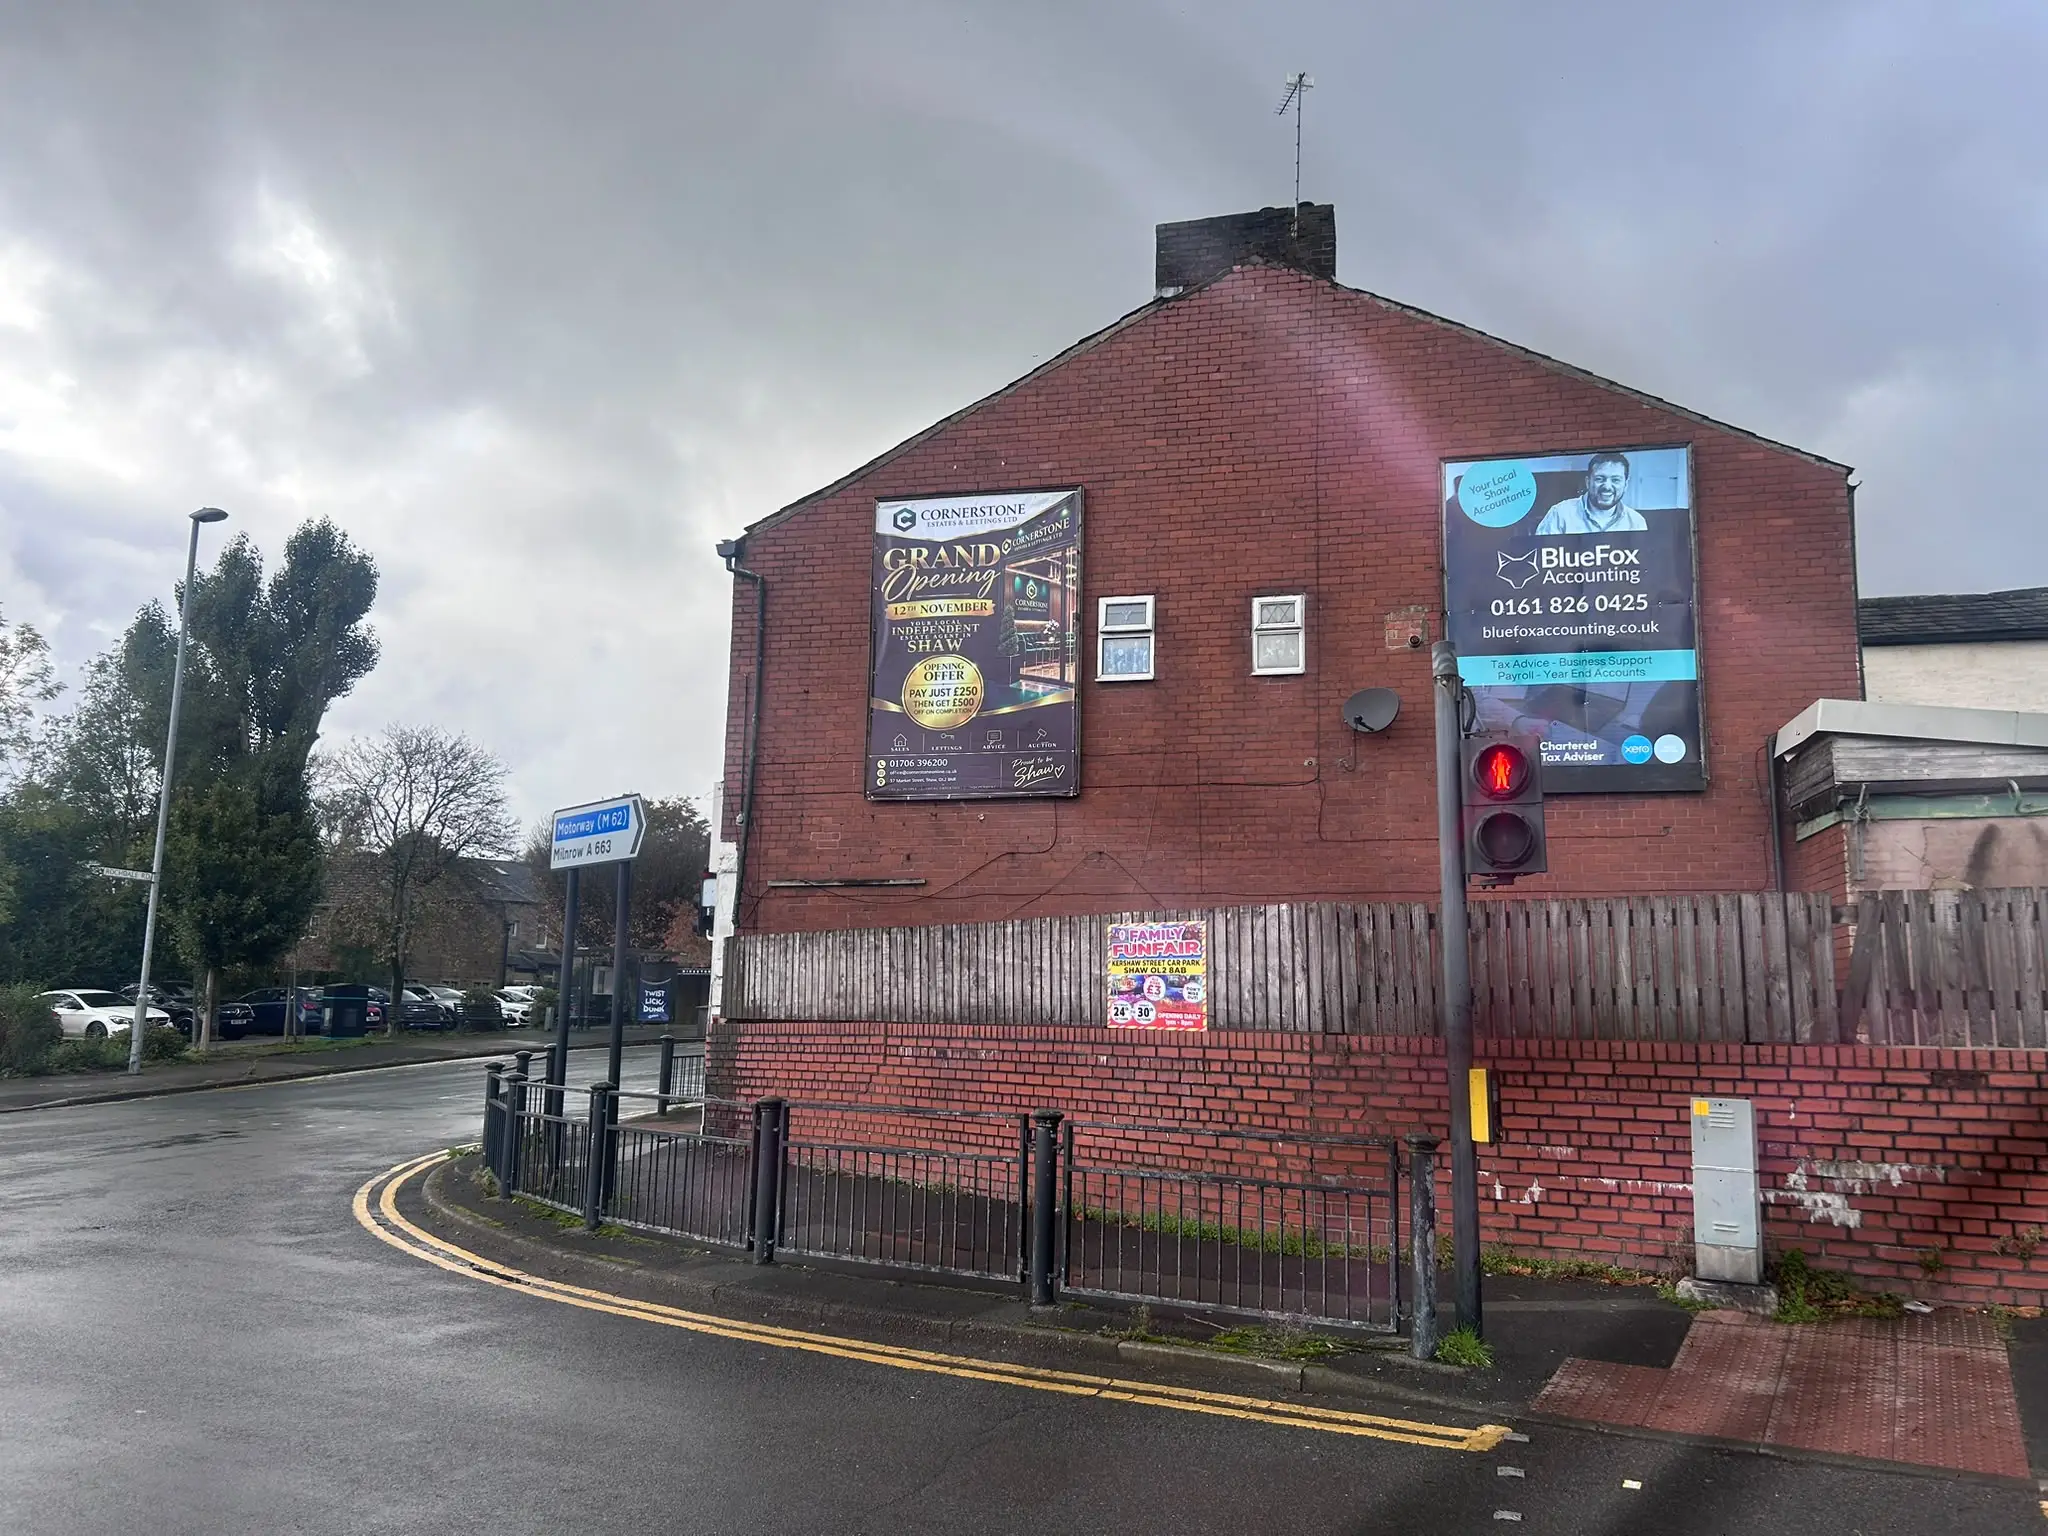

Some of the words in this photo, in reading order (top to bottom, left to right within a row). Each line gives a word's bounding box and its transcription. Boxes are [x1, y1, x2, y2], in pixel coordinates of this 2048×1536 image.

[1469, 482, 1490, 496] Your
[1492, 469, 1518, 487] Local
[1484, 484, 1511, 500] Shaw
[1472, 487, 1531, 517] Accountants
[921, 504, 1026, 521] CORNERSTONE
[927, 519, 957, 528] ESTATES
[958, 518, 964, 526] &
[965, 516, 1002, 526] LETTINGS
[1012, 517, 1070, 547] CORNERSTONE
[883, 542, 1001, 572] GRAND
[1541, 545, 1640, 569] BlueFox
[1542, 567, 1641, 585] Accounting
[881, 564, 1001, 602] Opening
[893, 604, 917, 616] 12TH
[919, 601, 988, 614] NOVEMBER
[1015, 598, 1048, 608] CORNERSTONE
[1491, 598, 1543, 616] 0161
[1550, 595, 1589, 613] 826
[1595, 593, 1648, 612] 0425
[891, 623, 980, 636] INDEPENDENT
[1483, 620, 1660, 639] bluefoxaccounting.co.uk
[907, 638, 964, 653] SHAW
[924, 662, 965, 672] OPENING
[1491, 660, 1511, 669] Tax
[1512, 658, 1549, 668] Advice
[1559, 657, 1606, 667] Business
[1608, 655, 1653, 667] Support
[923, 671, 965, 682] OFFER
[1498, 671, 1534, 682] Payroll
[1545, 670, 1569, 679] Year
[1571, 669, 1592, 678] End
[1594, 668, 1646, 678] Accounts
[909, 689, 927, 699] PAY
[929, 688, 951, 698] JUST
[953, 686, 978, 697] £250
[914, 699, 934, 708] THEN
[935, 699, 950, 707] GET
[952, 698, 975, 707] £500
[935, 707, 973, 715] COMPLETION
[1539, 740, 1597, 751] Chartered
[1624, 745, 1650, 754] xero
[889, 759, 915, 768] 01706
[917, 758, 948, 767] 396200
[1012, 757, 1035, 769] Proud
[1037, 756, 1044, 764] to
[1540, 752, 1561, 762] Tax
[1562, 751, 1604, 762] Adviser
[1014, 764, 1054, 787] Shaw
[557, 820, 595, 836] Motorway
[597, 813, 609, 831] (M
[611, 808, 627, 827] 62)
[553, 846, 584, 861] Milnrow
[586, 843, 592, 856] A
[594, 839, 612, 855] 663
[105, 868, 138, 878] ROCHDALE
[141, 872, 151, 880] RD
[1129, 926, 1186, 941] FAMILY
[1112, 941, 1201, 958] FUNFAIR
[1150, 966, 1167, 974] OL2
[1168, 966, 1187, 974] 8AB
[644, 989, 666, 998] TWIST
[1146, 985, 1162, 995] £3
[645, 998, 664, 1006] LICK
[642, 1005, 665, 1013] DUNK
[1184, 1012, 1201, 1020] DAILY
